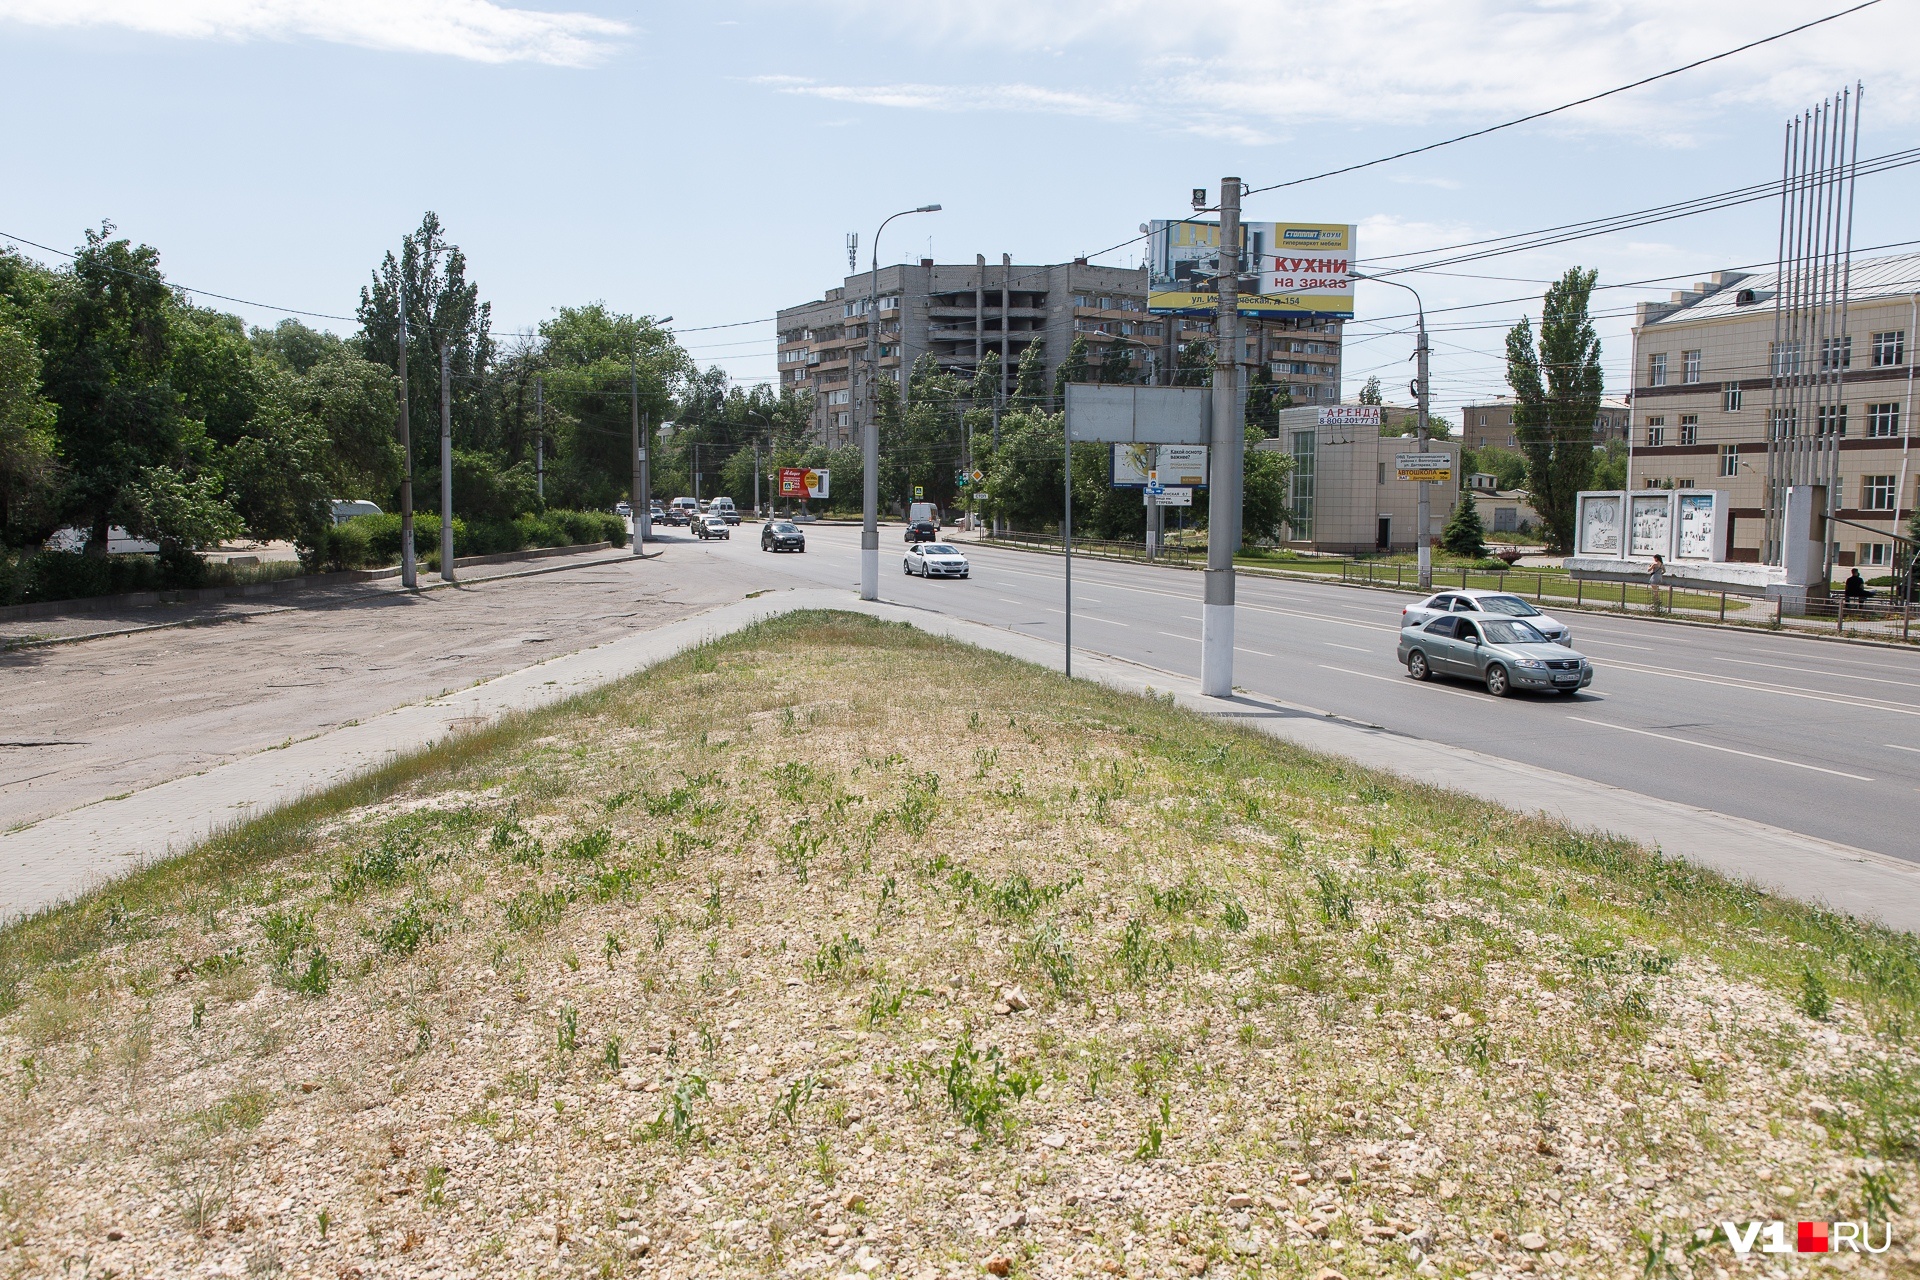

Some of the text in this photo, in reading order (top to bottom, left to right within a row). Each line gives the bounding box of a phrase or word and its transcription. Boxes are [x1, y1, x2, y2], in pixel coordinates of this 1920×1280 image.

[1275, 257, 1347, 273] КУХНИ
[1275, 278, 1347, 289] на заказ
[1191, 296, 1205, 304] ул.
[1285, 297, 1300, 305] 154
[1327, 408, 1379, 417] АРЕНДА
